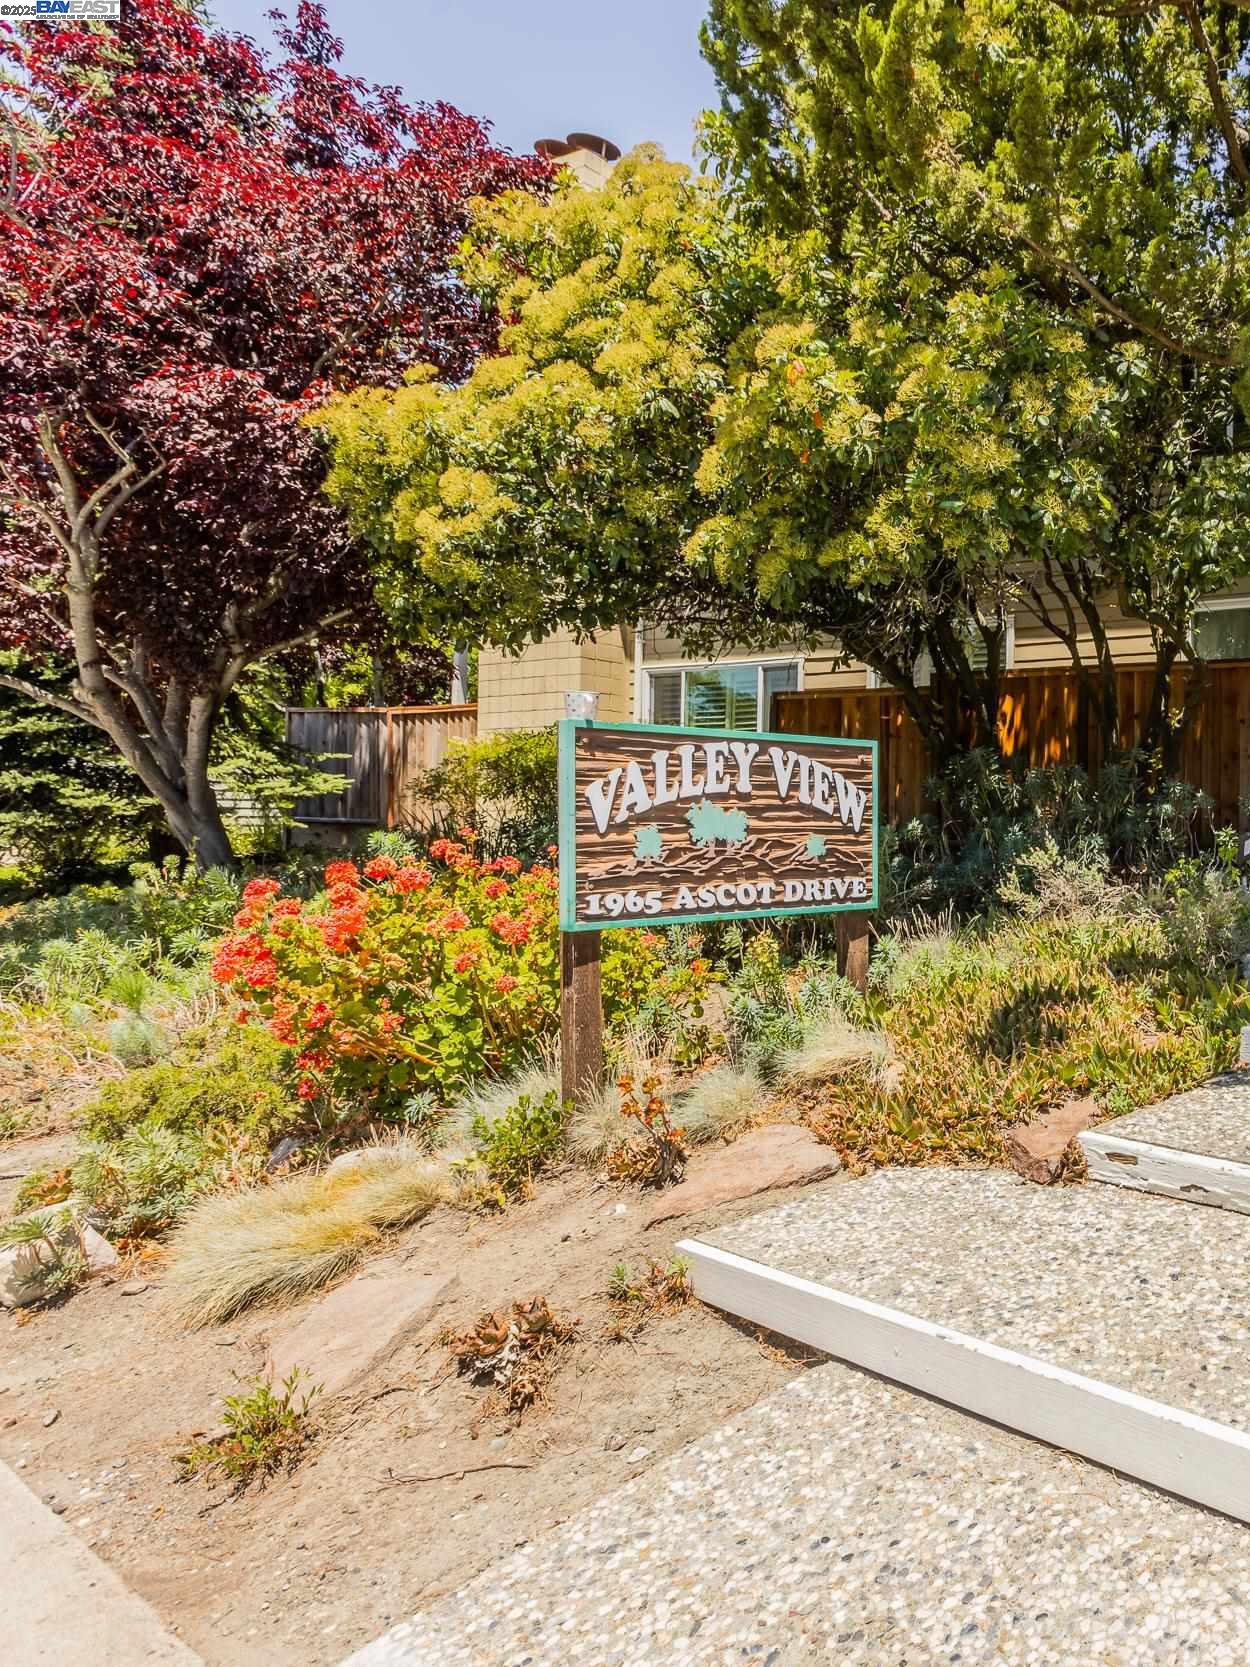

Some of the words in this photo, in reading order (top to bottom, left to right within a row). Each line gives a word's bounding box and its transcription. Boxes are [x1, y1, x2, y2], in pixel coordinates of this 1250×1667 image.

[586, 742, 759, 833] VALLEY
[768, 747, 867, 833] VIEW
[586, 891, 663, 916] 1965
[674, 883, 776, 910] ASCOT
[784, 877, 867, 900] DRIVE
